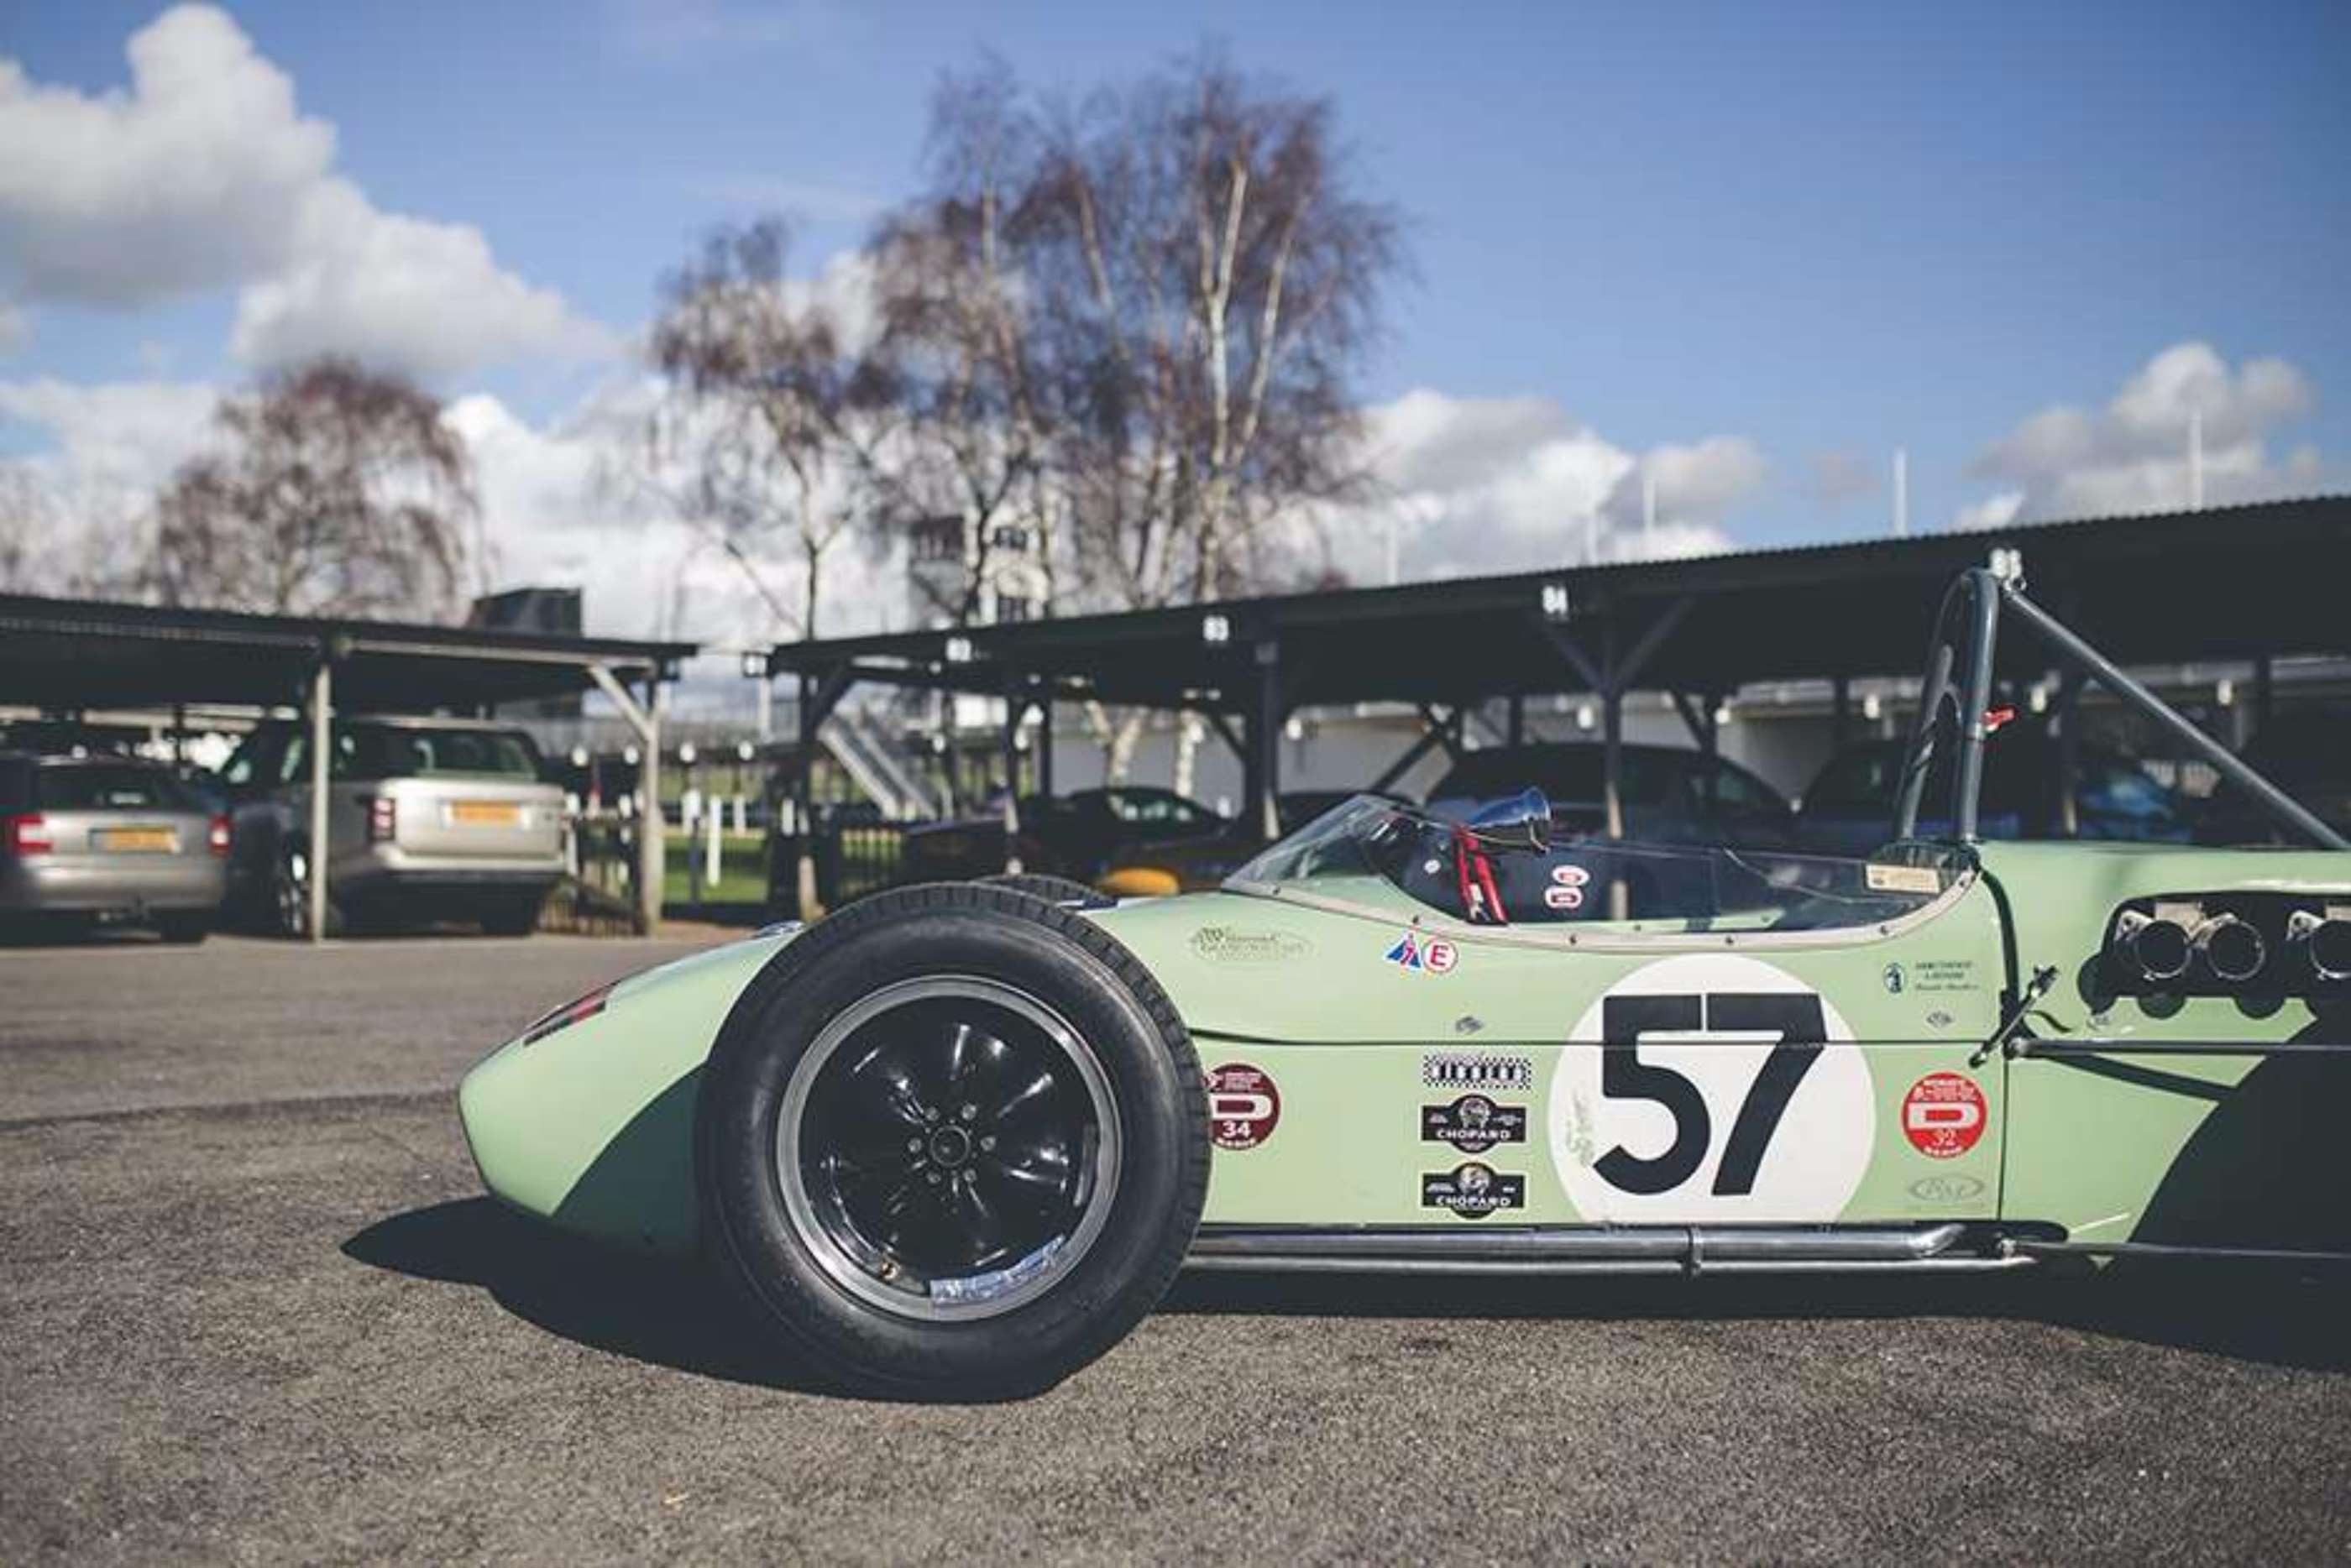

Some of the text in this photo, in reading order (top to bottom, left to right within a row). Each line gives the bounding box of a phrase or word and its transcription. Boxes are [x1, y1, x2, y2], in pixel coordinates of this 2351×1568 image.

[1430, 945, 1449, 966] E
[1594, 993, 1827, 1196] 57
[1222, 1120, 1252, 1138] 34
